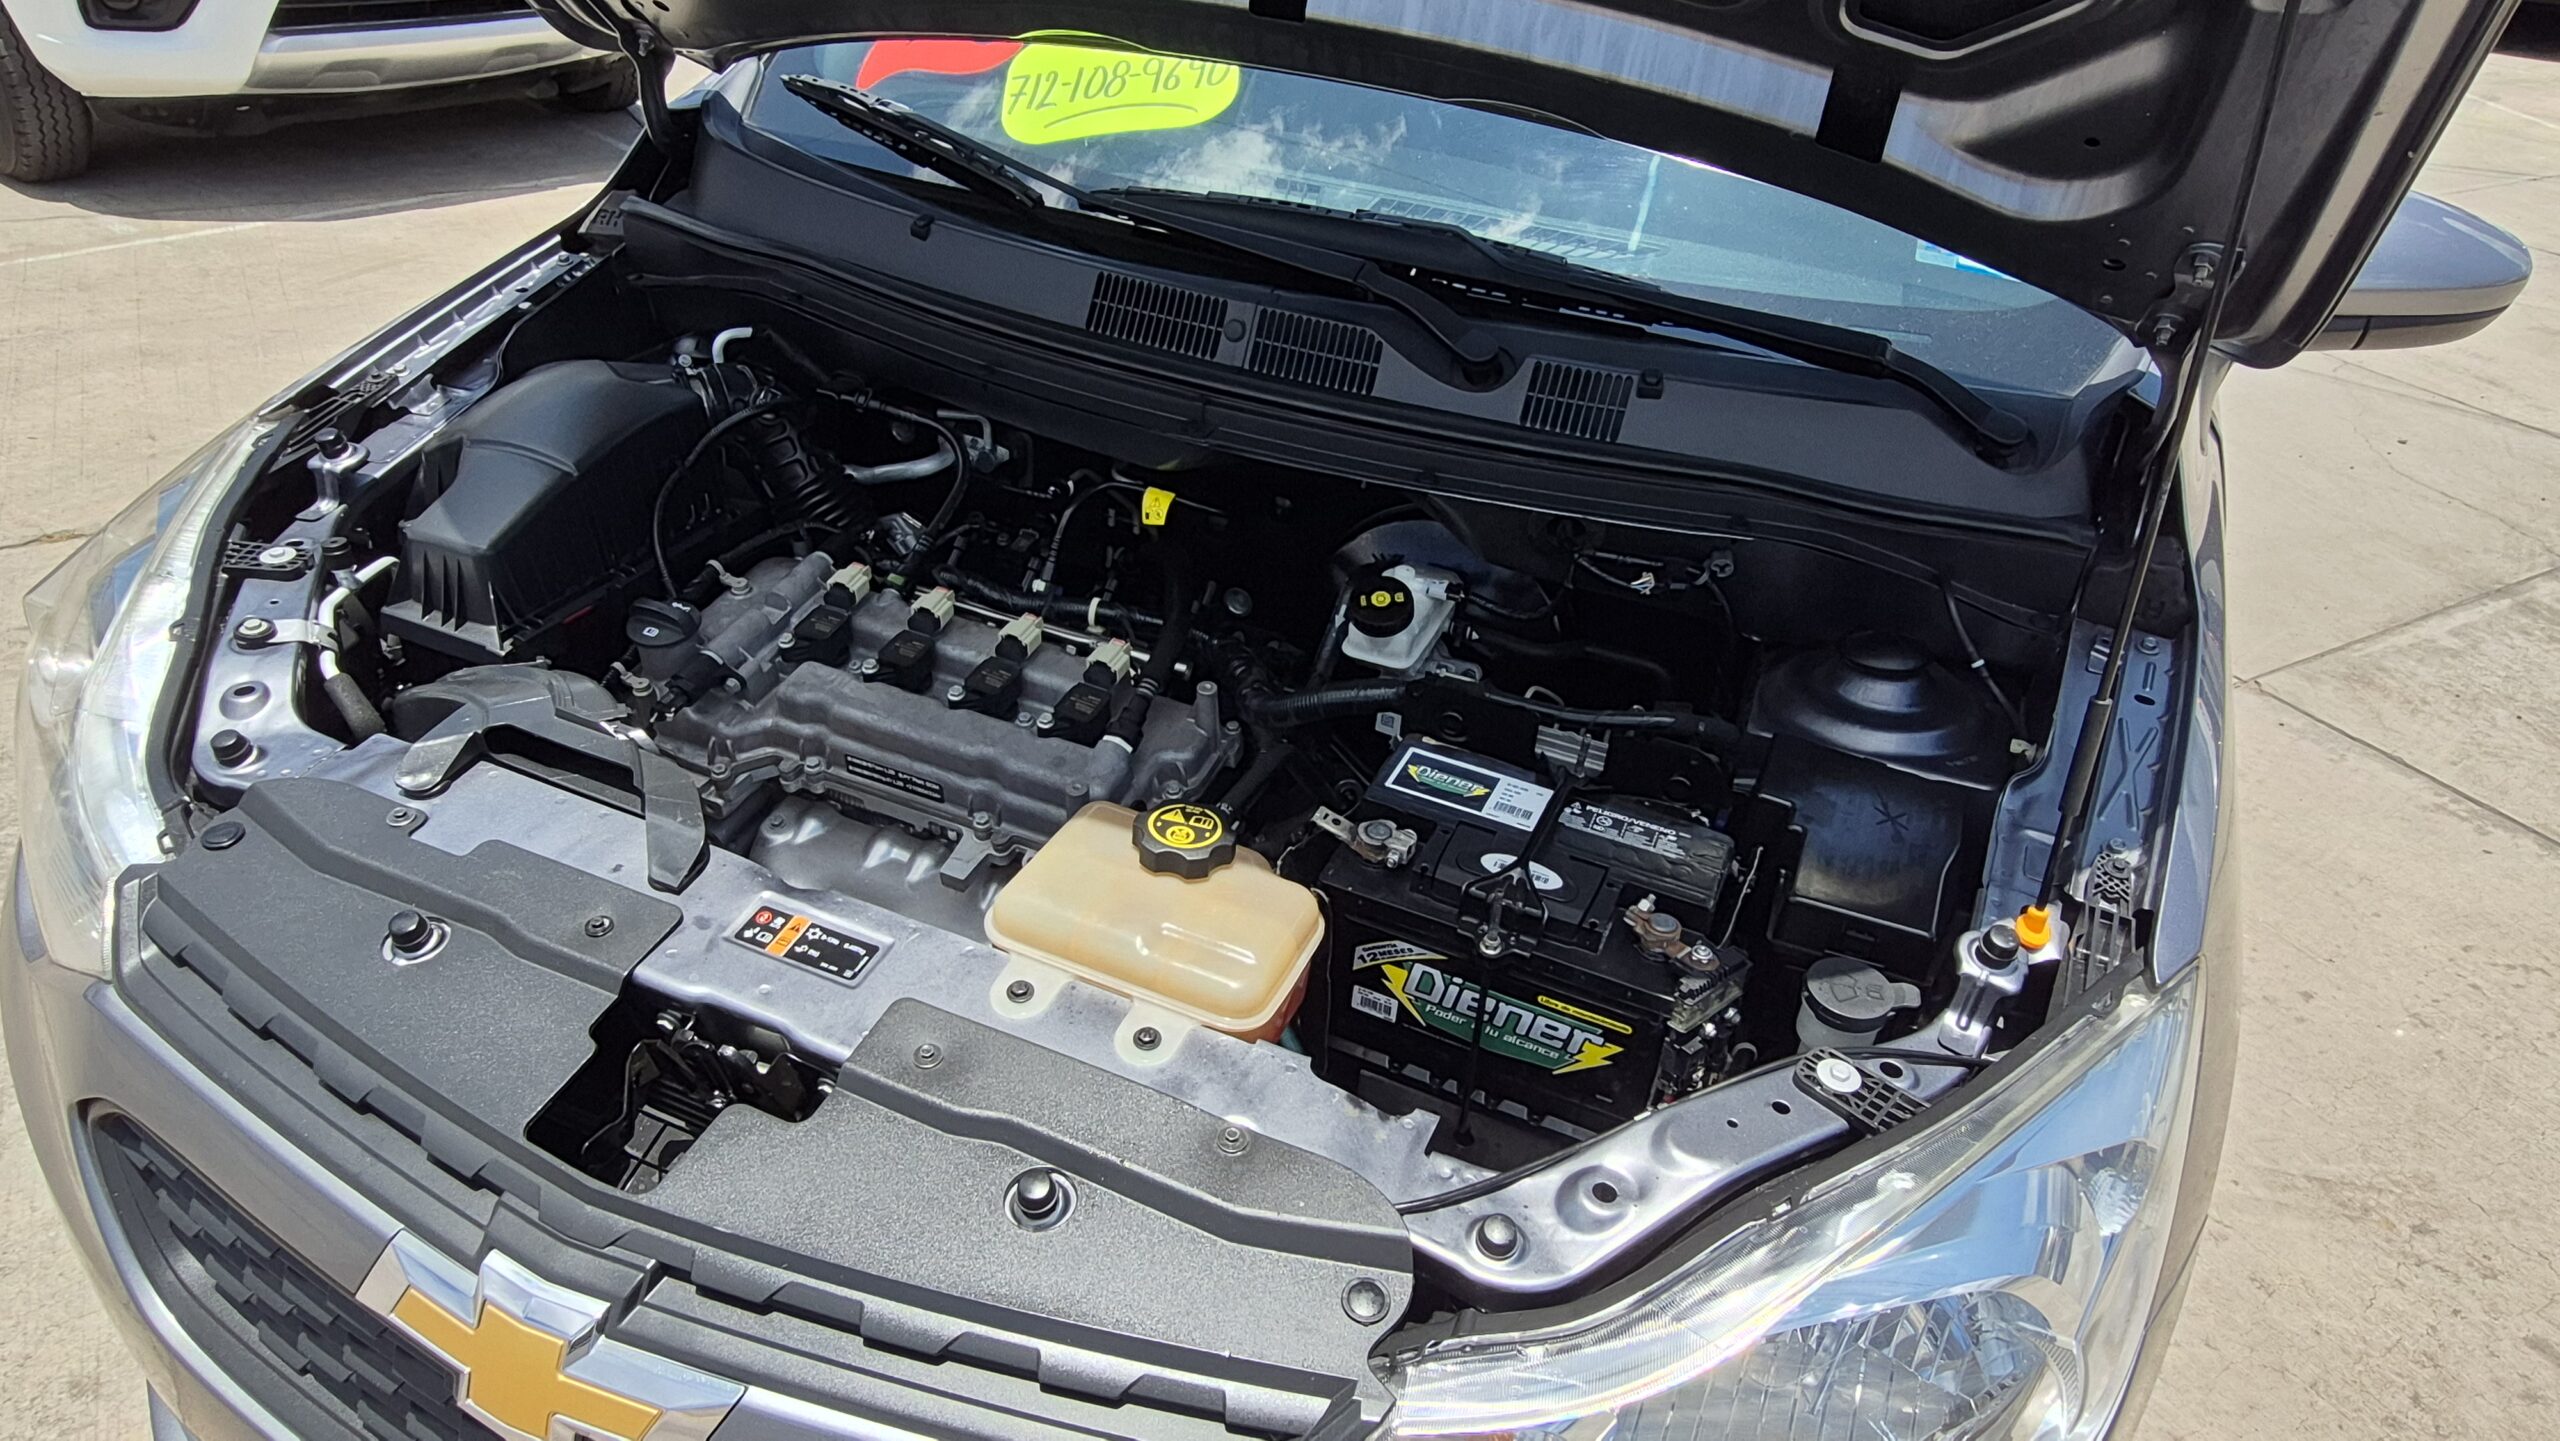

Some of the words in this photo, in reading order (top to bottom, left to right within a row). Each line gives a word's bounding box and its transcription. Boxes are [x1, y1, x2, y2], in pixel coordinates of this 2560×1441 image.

[1417, 765, 1485, 792] Diener
[1357, 952, 1378, 964] 12
[1378, 947, 1414, 957] MESES
[1403, 962, 1605, 1055] Diener
[1425, 1004, 1467, 1025] Poder
[1503, 1034, 1560, 1060] alcance
